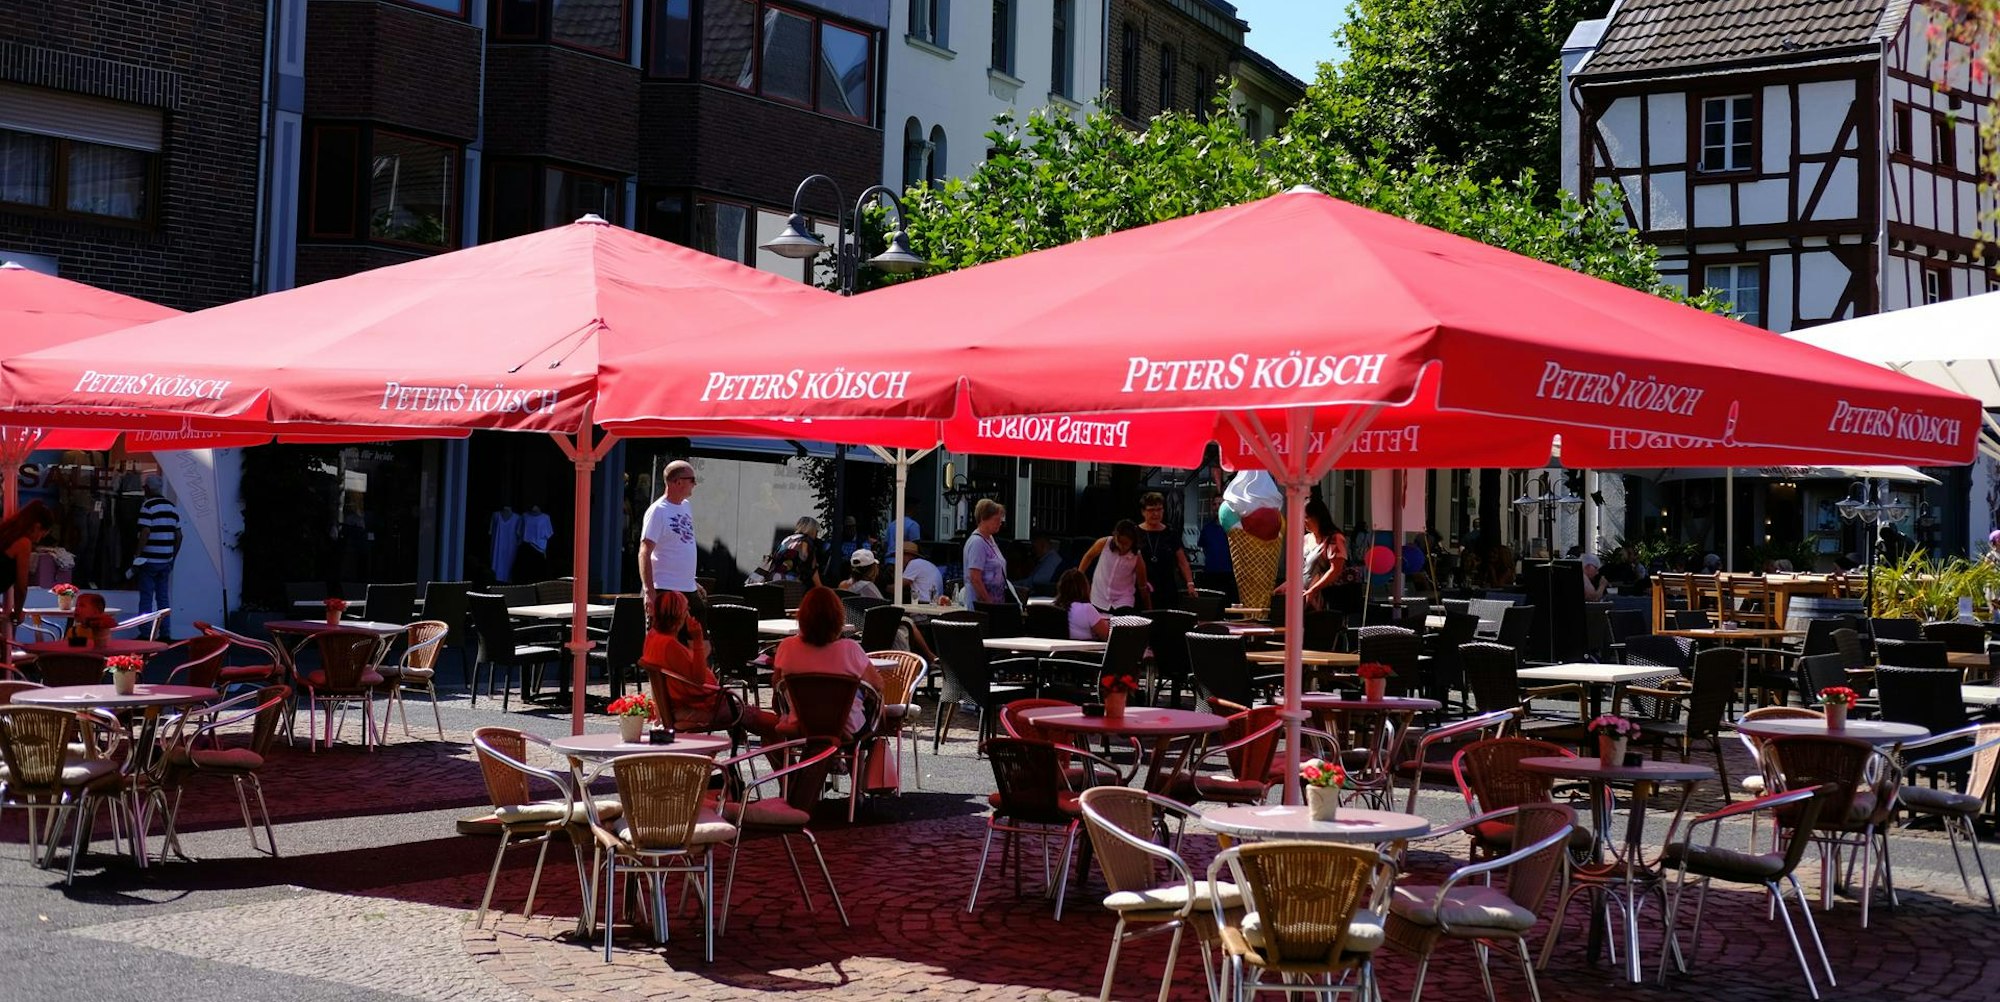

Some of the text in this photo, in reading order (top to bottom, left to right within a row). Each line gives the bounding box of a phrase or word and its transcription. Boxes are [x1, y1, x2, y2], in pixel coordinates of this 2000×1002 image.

[73, 370, 232, 400] PETERS KÖLSCH
[700, 367, 911, 401] PETERS KÖLSCH
[1121, 350, 1388, 393] PETERS KÖLSCH
[1536, 361, 1704, 416] PETERS KÖLSCH
[379, 381, 559, 416] PETERS KÖLSCH
[1828, 400, 1961, 446] PETERS KÖLSCH
